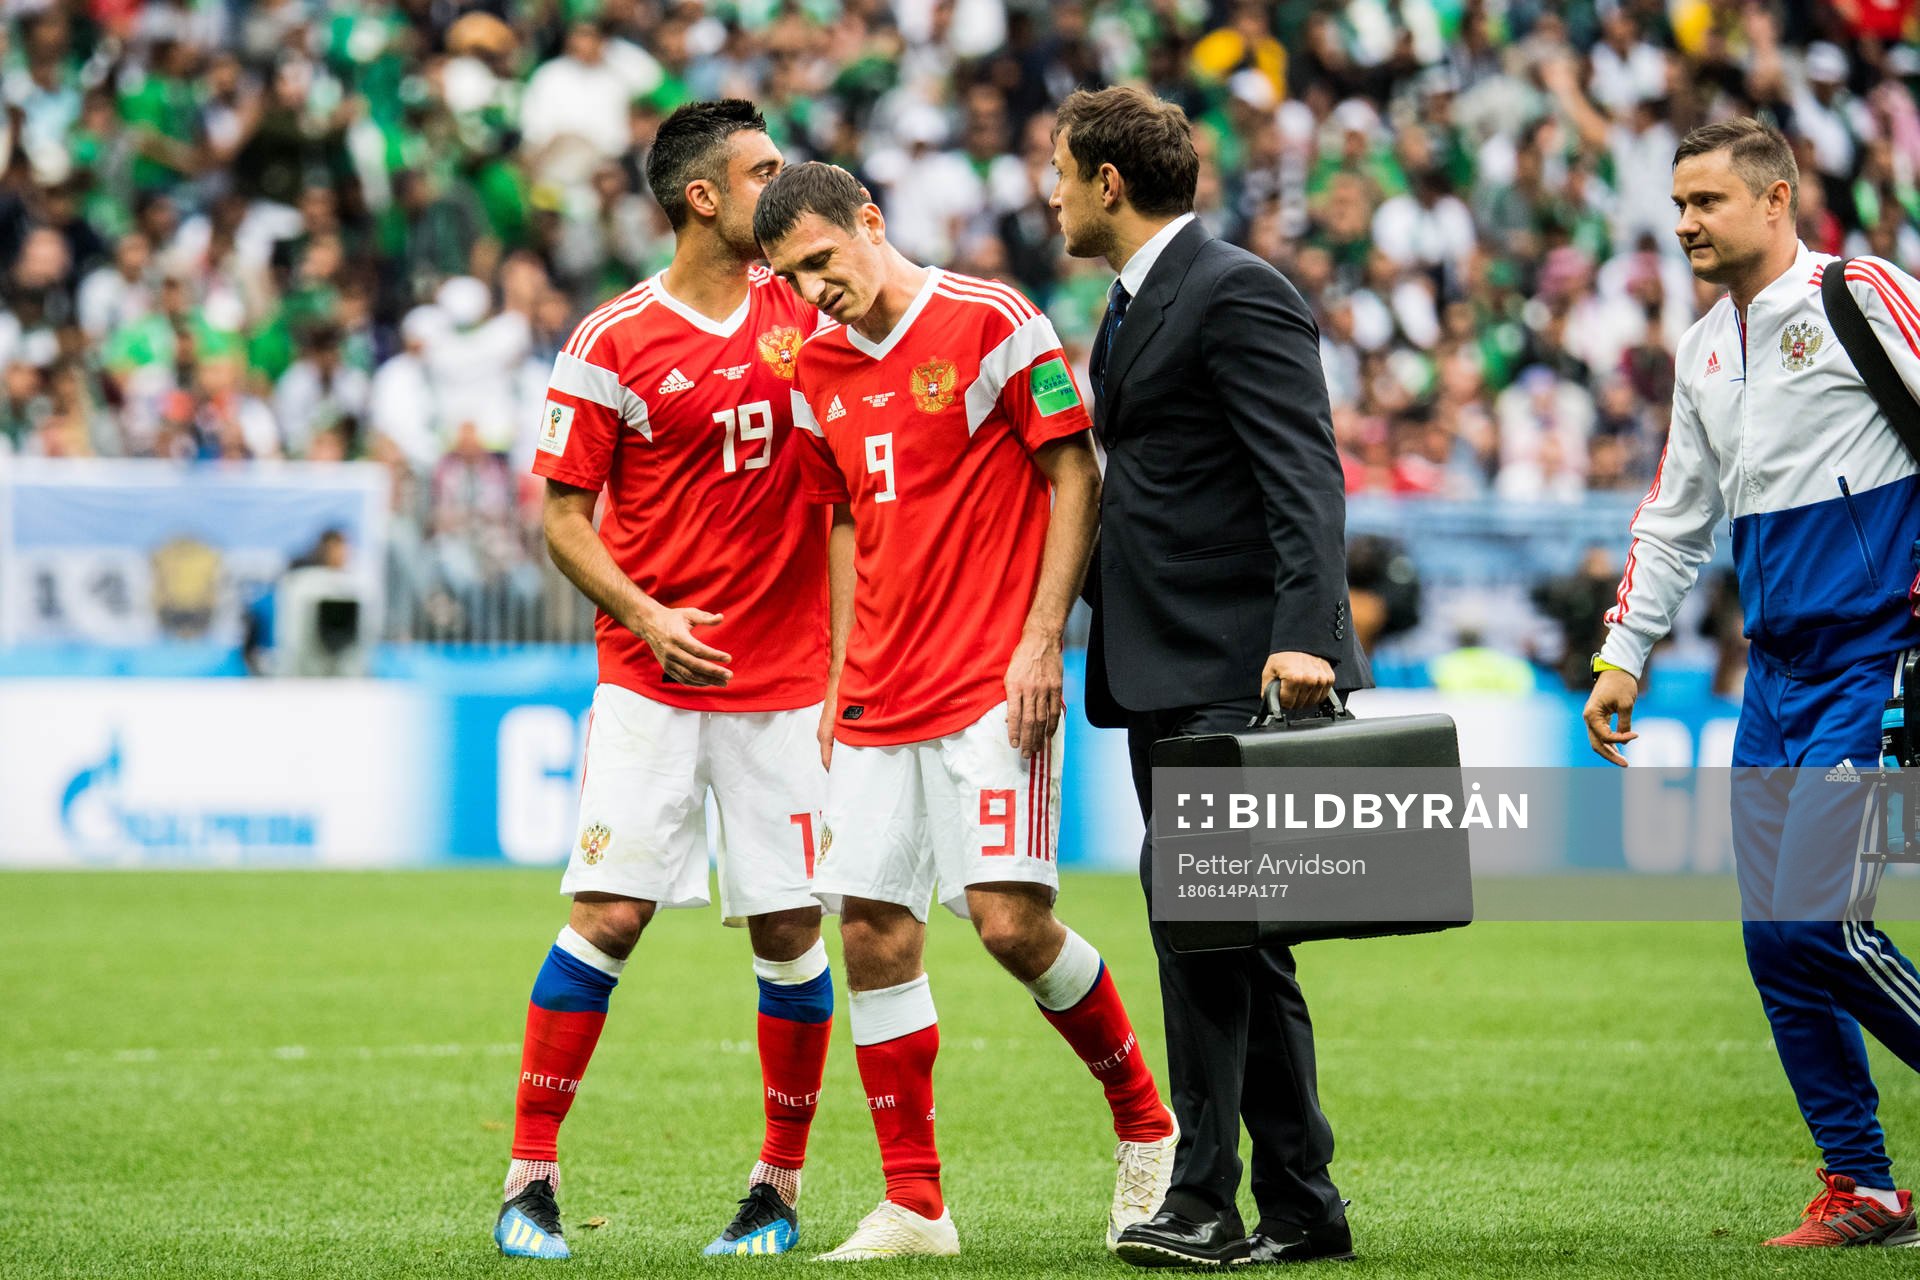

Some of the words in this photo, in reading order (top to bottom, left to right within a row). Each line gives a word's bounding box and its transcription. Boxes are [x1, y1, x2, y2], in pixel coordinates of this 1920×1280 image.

[658, 380, 695, 395] adidas
[712, 400, 773, 473] 19
[865, 432, 896, 504] 9
[1825, 772, 1861, 783] adidas
[789, 811, 822, 880] 1
[980, 789, 1016, 856] 9
